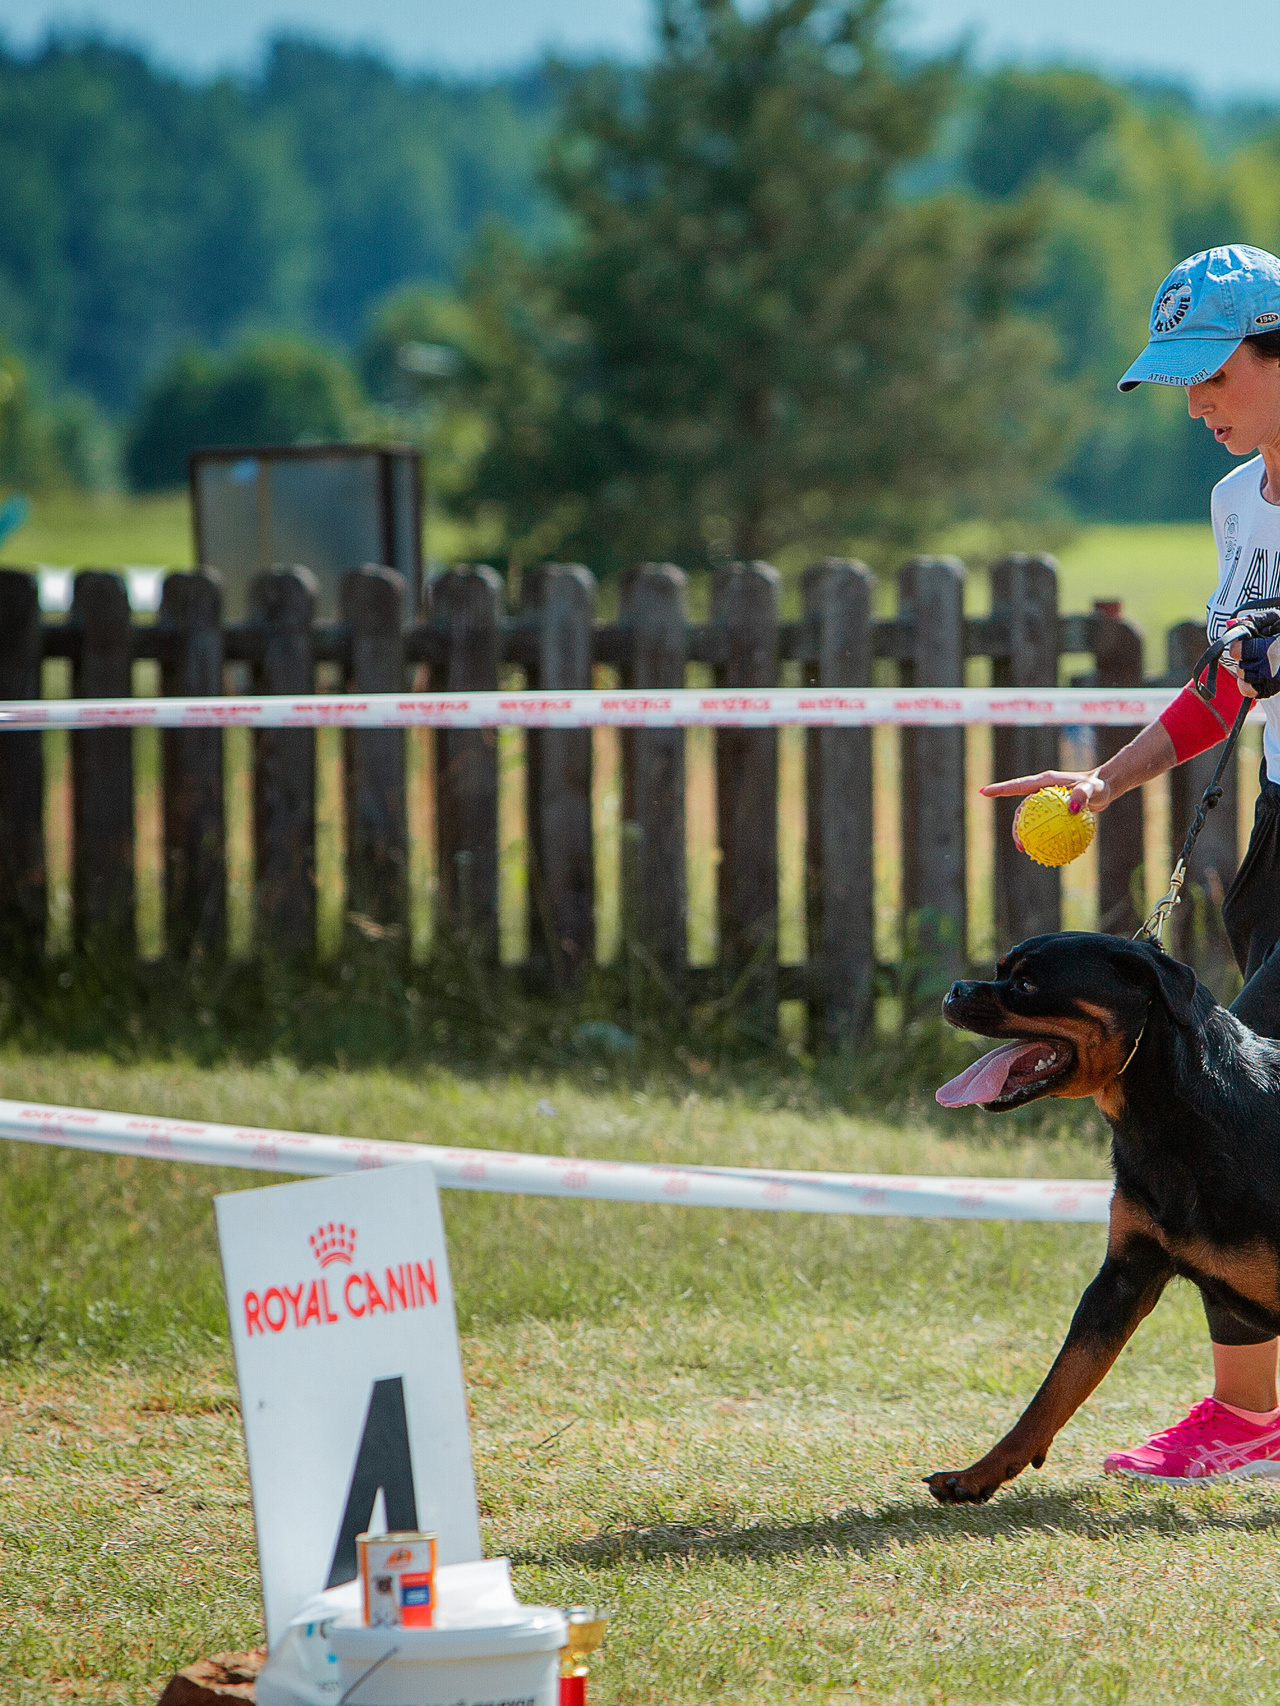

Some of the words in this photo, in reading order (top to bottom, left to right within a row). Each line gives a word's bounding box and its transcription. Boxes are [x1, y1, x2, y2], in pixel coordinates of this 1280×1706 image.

[1165, 296, 1191, 332] LEAGUE
[1147, 373, 1188, 386] ATHLETIC
[244, 1278, 338, 1337] ROYAL
[344, 1258, 437, 1318] CANIN
